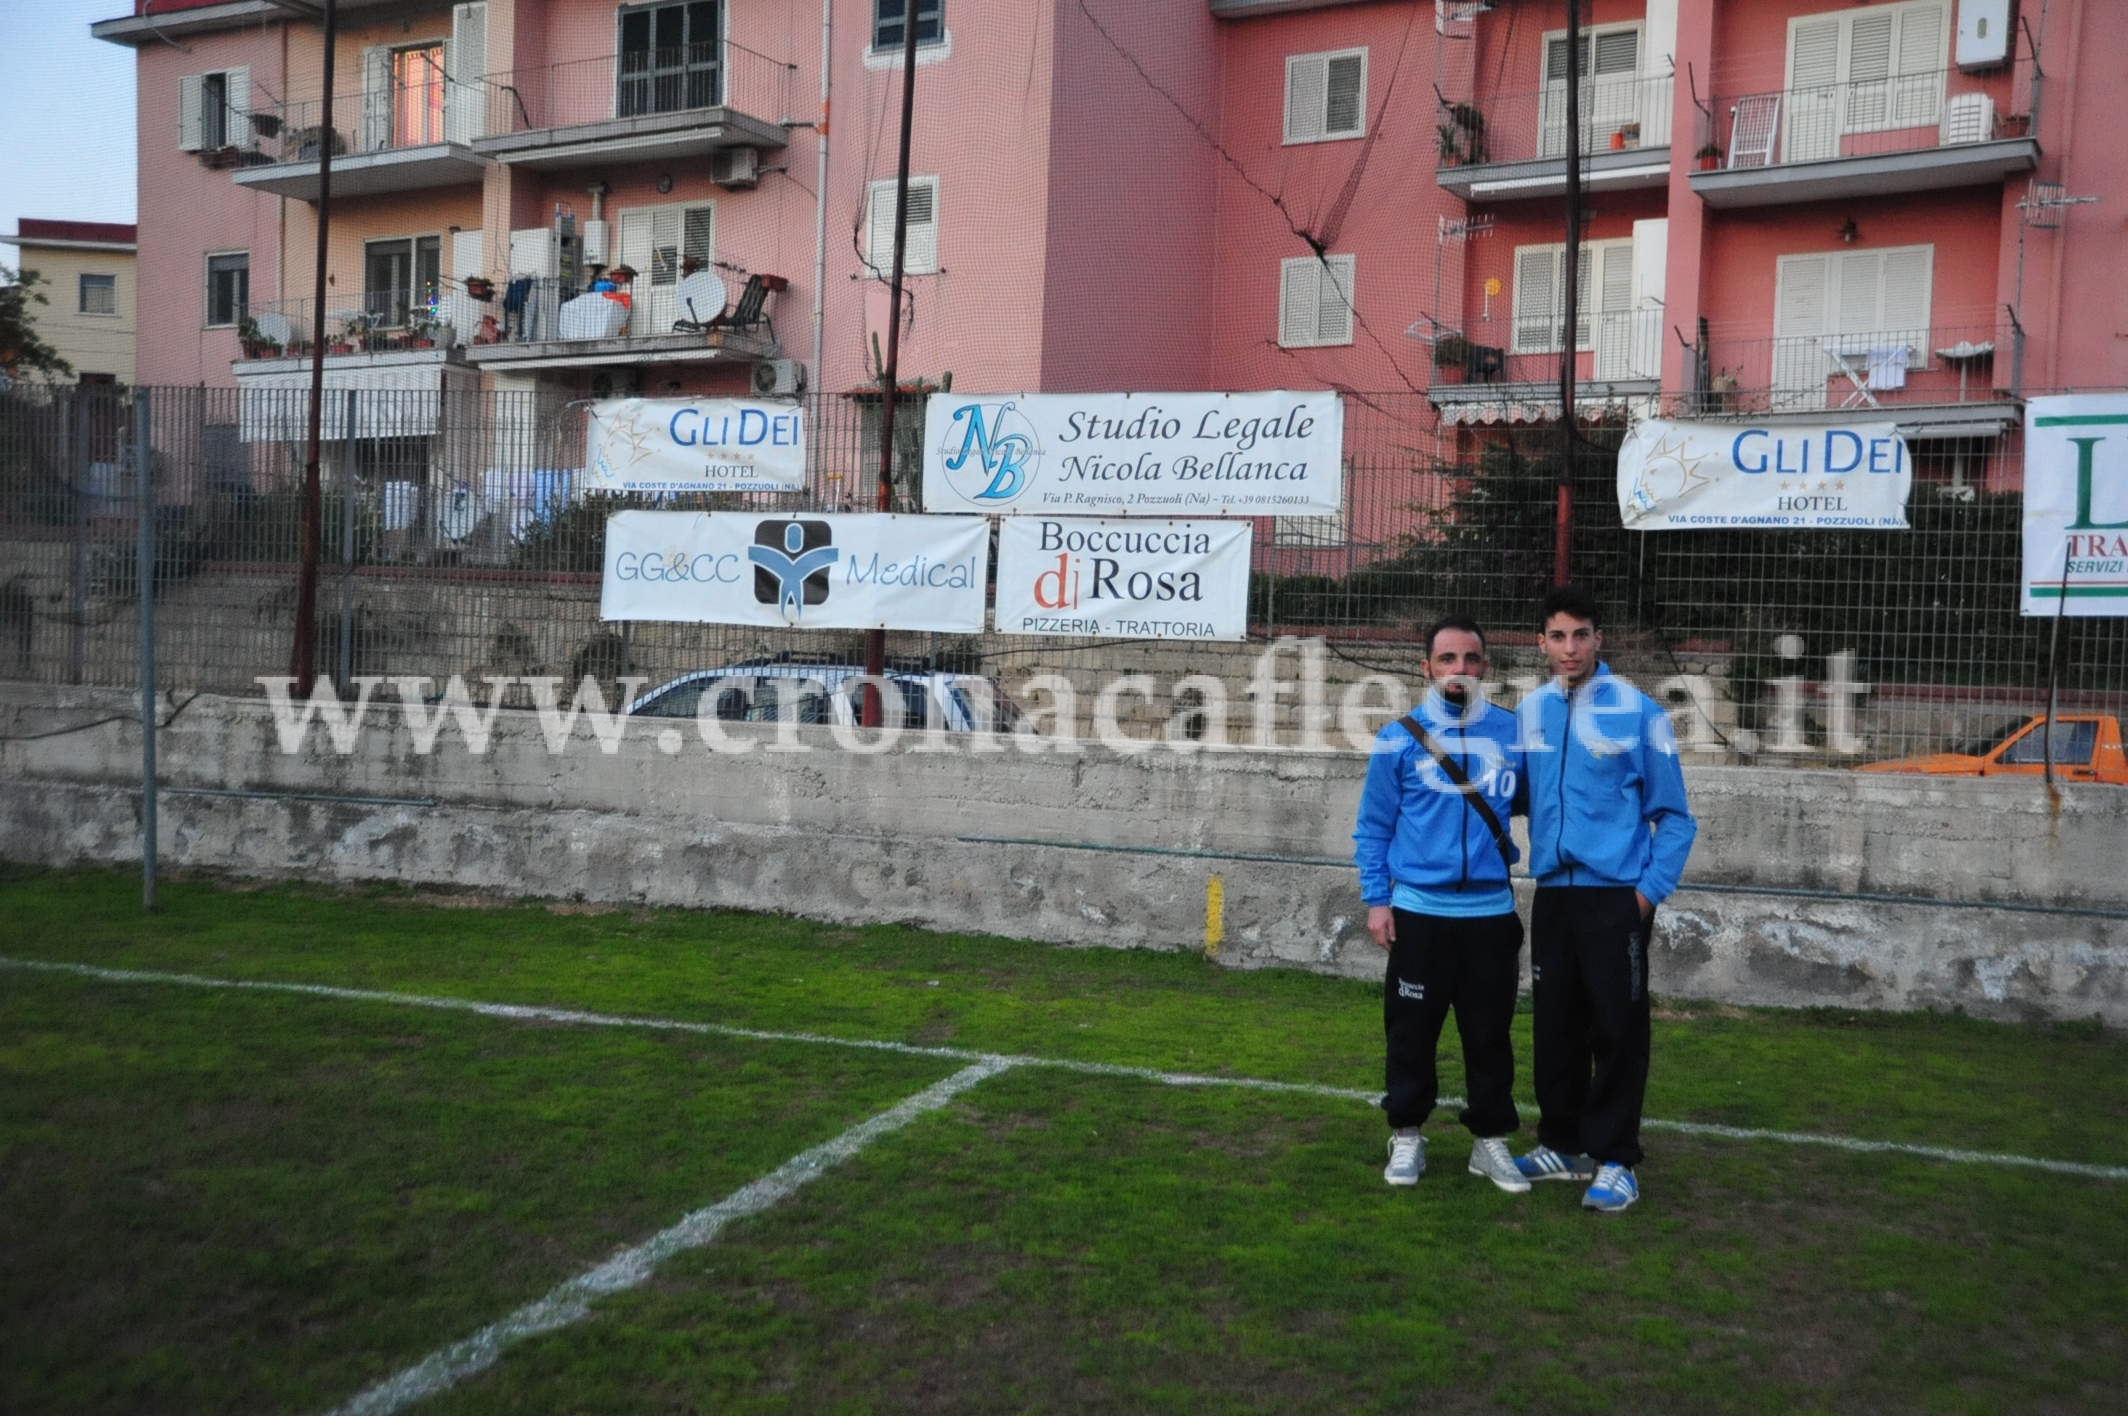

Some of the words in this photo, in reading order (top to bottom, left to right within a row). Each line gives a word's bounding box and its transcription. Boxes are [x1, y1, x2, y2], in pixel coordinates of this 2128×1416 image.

[669, 408, 728, 446] GLI
[738, 408, 798, 445] DEI
[1059, 406, 1181, 442] Studio
[1192, 404, 1315, 450] Legale
[1058, 454, 1163, 482] Nicola
[1172, 451, 1309, 482] Bellanca
[1732, 429, 1808, 474] GLI
[1824, 430, 1902, 474] DEI
[639, 482, 667, 490] COSTE
[670, 482, 715, 490] D'AGNANO
[716, 482, 727, 490] 21
[735, 482, 779, 490] POZZUOLI
[704, 465, 759, 478] HOTEL
[1042, 492, 1061, 504] Via
[1127, 493, 1135, 504] 2
[1137, 492, 1183, 504] Pozzuoli
[1184, 492, 1211, 506] (Na)
[1778, 496, 1848, 511] HOTEL
[1668, 515, 1687, 524] VIA
[1690, 515, 1727, 524] COSTE
[1730, 516, 1790, 525] D'AGNANO
[1793, 516, 1806, 525] 21
[1816, 517, 1875, 526] POZZUOLI
[1040, 521, 1211, 555] Boccuccia
[616, 552, 741, 583] GG&CC
[846, 553, 976, 589] Medical
[1033, 553, 1081, 610] di
[1088, 558, 1204, 602] Rosa
[2066, 560, 2124, 573] SERVIZI
[1022, 617, 1100, 633] PIZZERIA
[1116, 620, 1216, 637] TRATTORIA
[1483, 769, 1517, 798] 10
